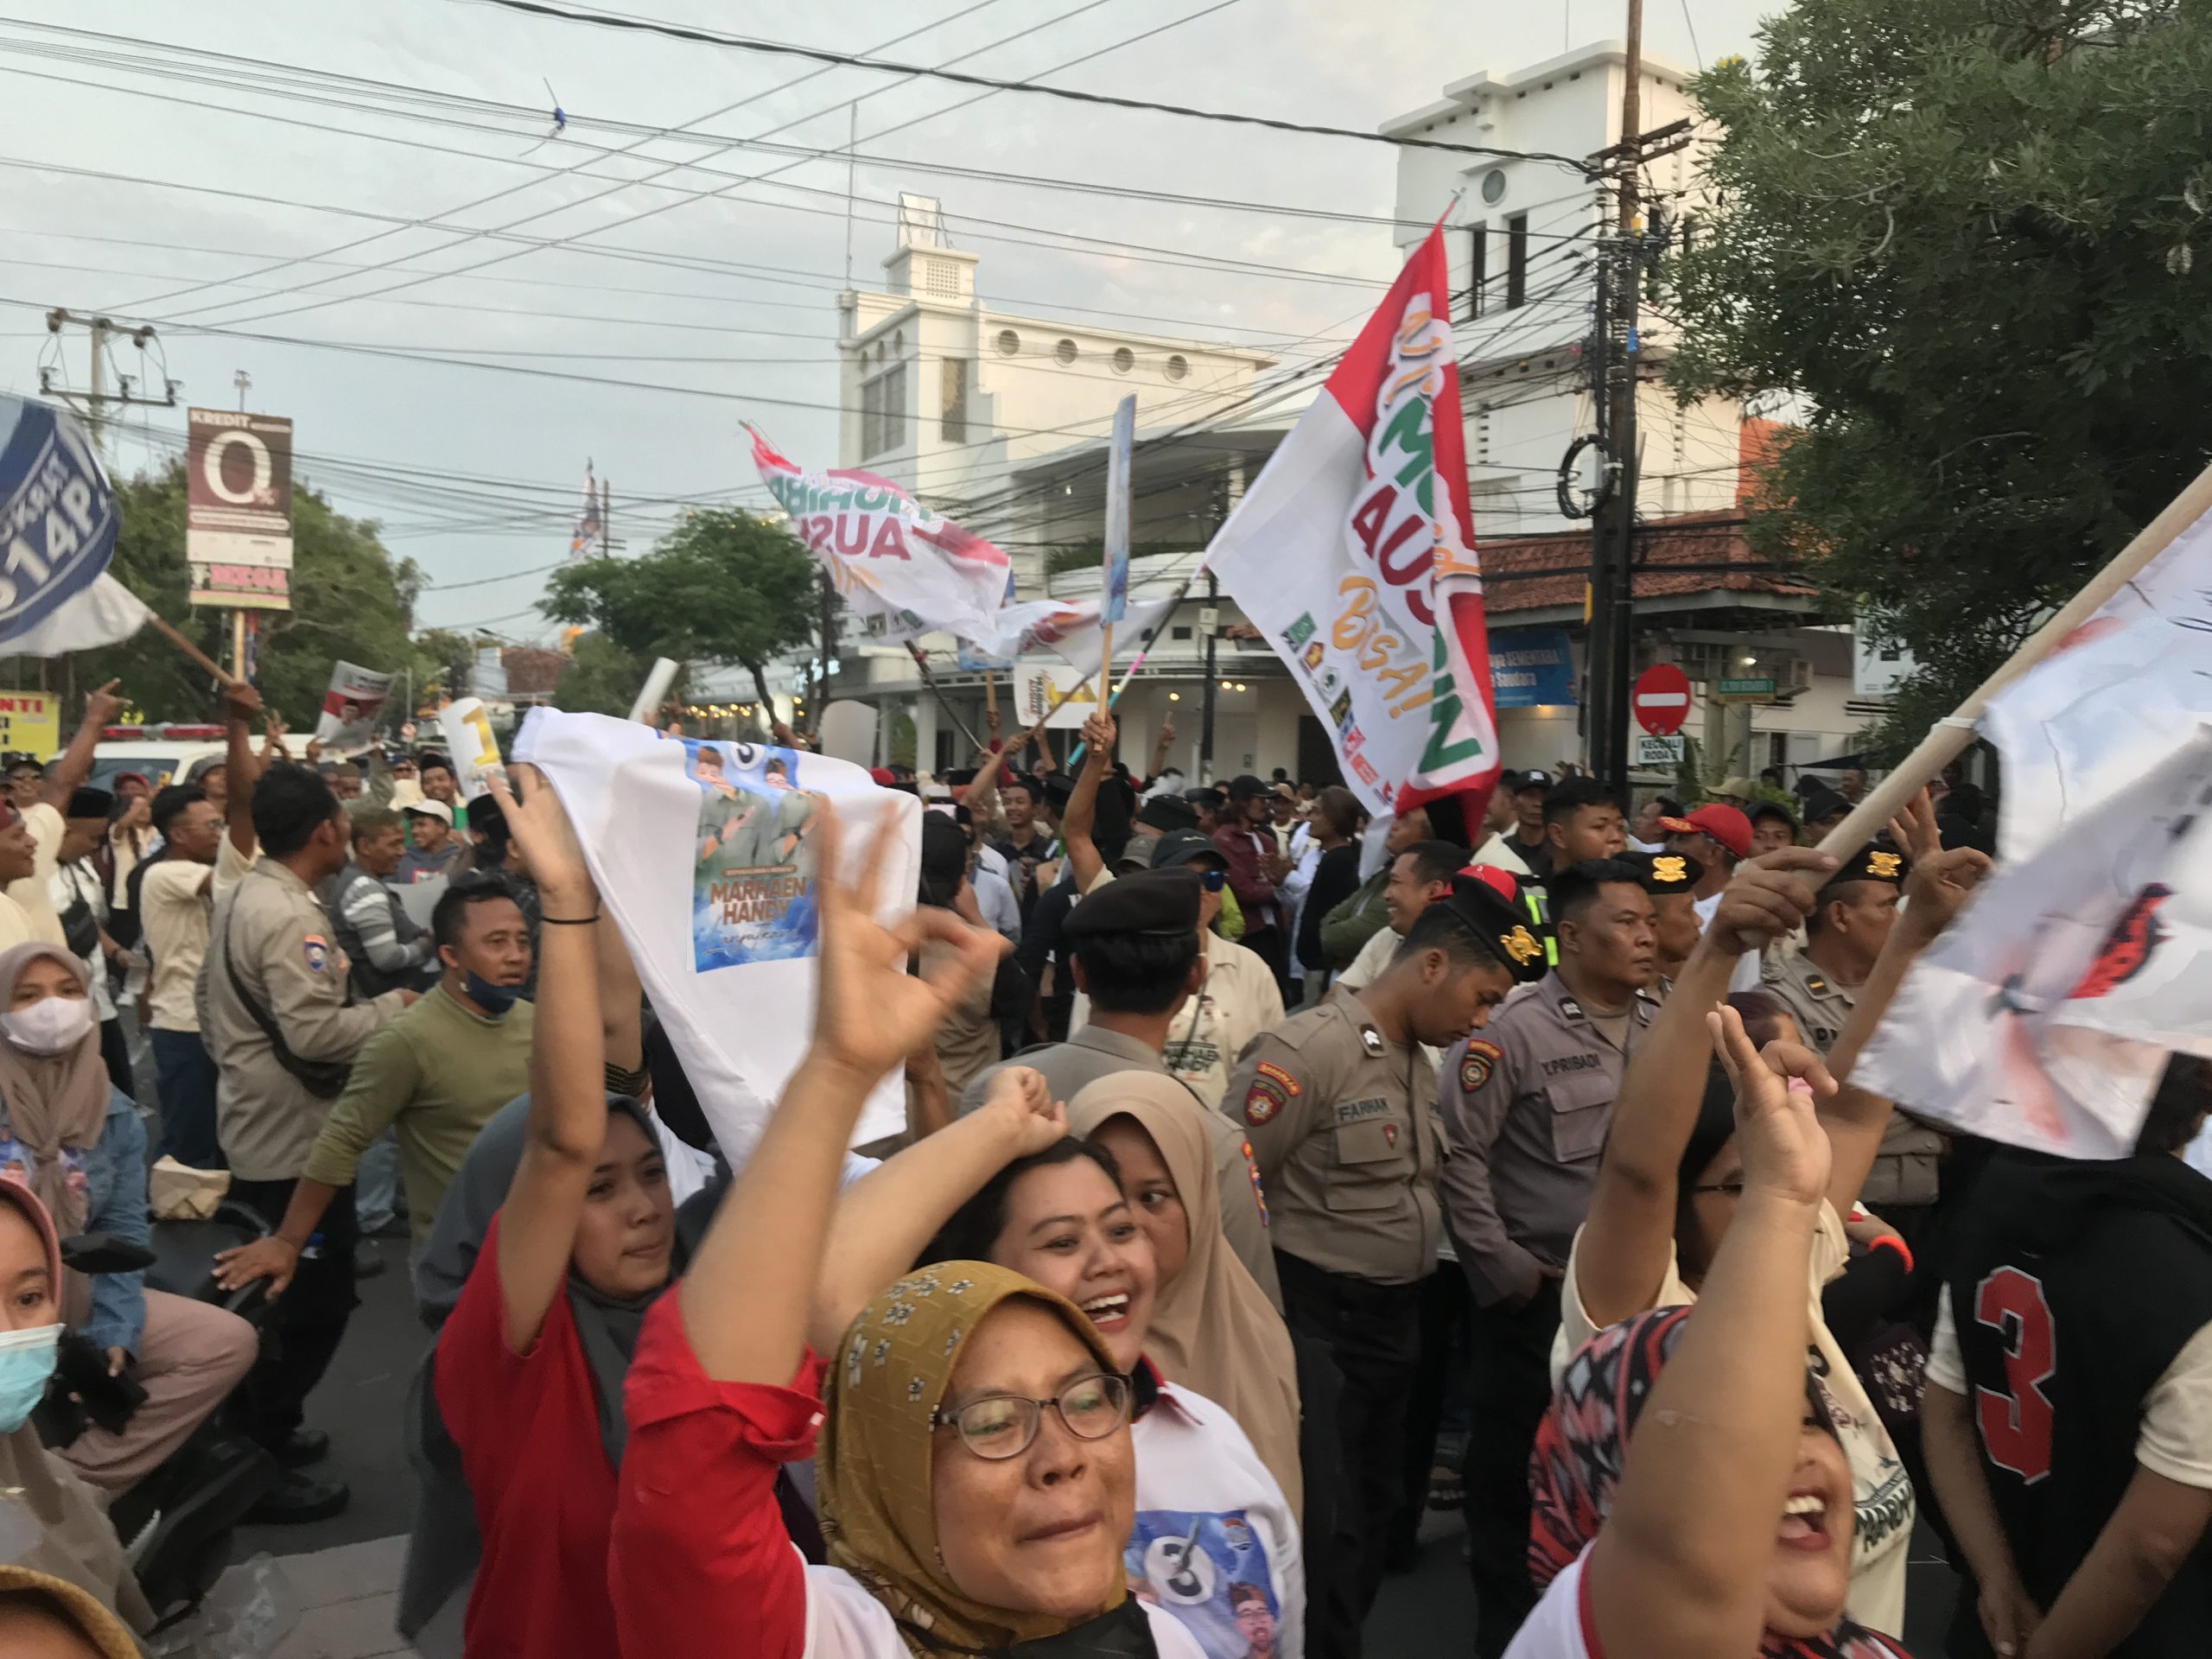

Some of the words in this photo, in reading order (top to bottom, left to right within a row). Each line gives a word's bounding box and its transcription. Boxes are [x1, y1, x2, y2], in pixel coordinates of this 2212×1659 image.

[191, 410, 251, 429] KREDIT
[461, 704, 499, 766] 1
[709, 878, 805, 903] MARHAEN
[723, 900, 789, 925] HANDY
[1974, 1265, 2056, 1485] 3
